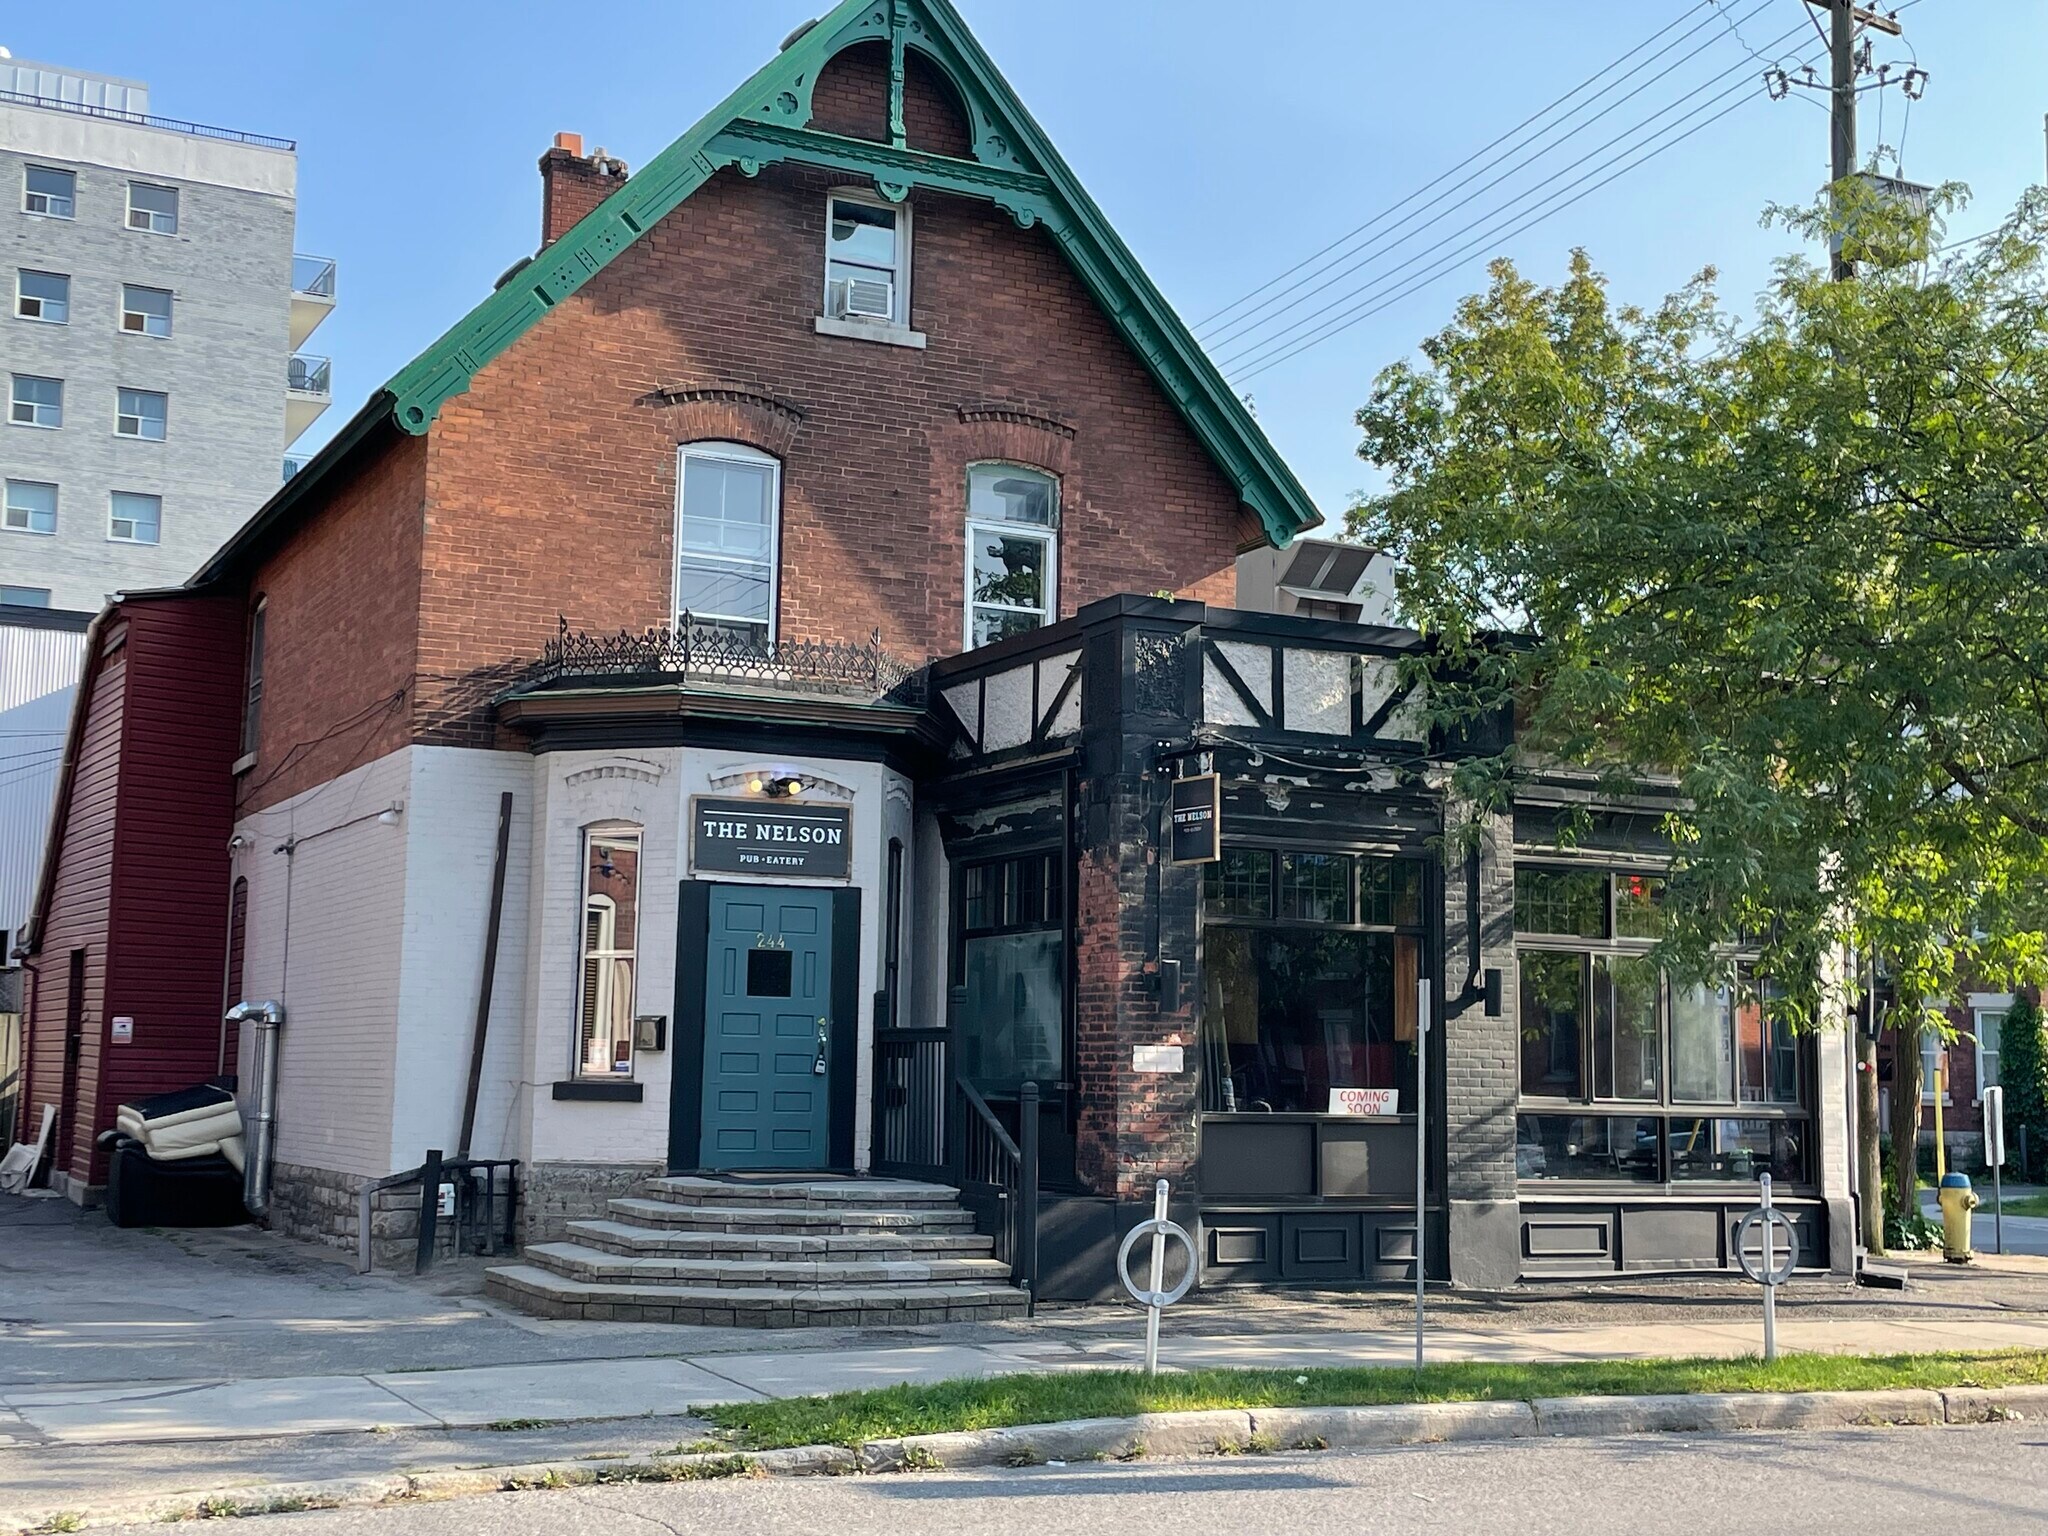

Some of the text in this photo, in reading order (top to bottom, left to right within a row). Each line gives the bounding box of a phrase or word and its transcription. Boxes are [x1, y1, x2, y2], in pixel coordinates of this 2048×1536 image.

[1174, 810, 1212, 823] THE NELSON
[703, 821, 842, 845] THE NELSON
[739, 854, 805, 866] PUB EATERY
[756, 932, 785, 949] 244
[1340, 1090, 1390, 1103] COMING
[1347, 1103, 1381, 1115] SOON
